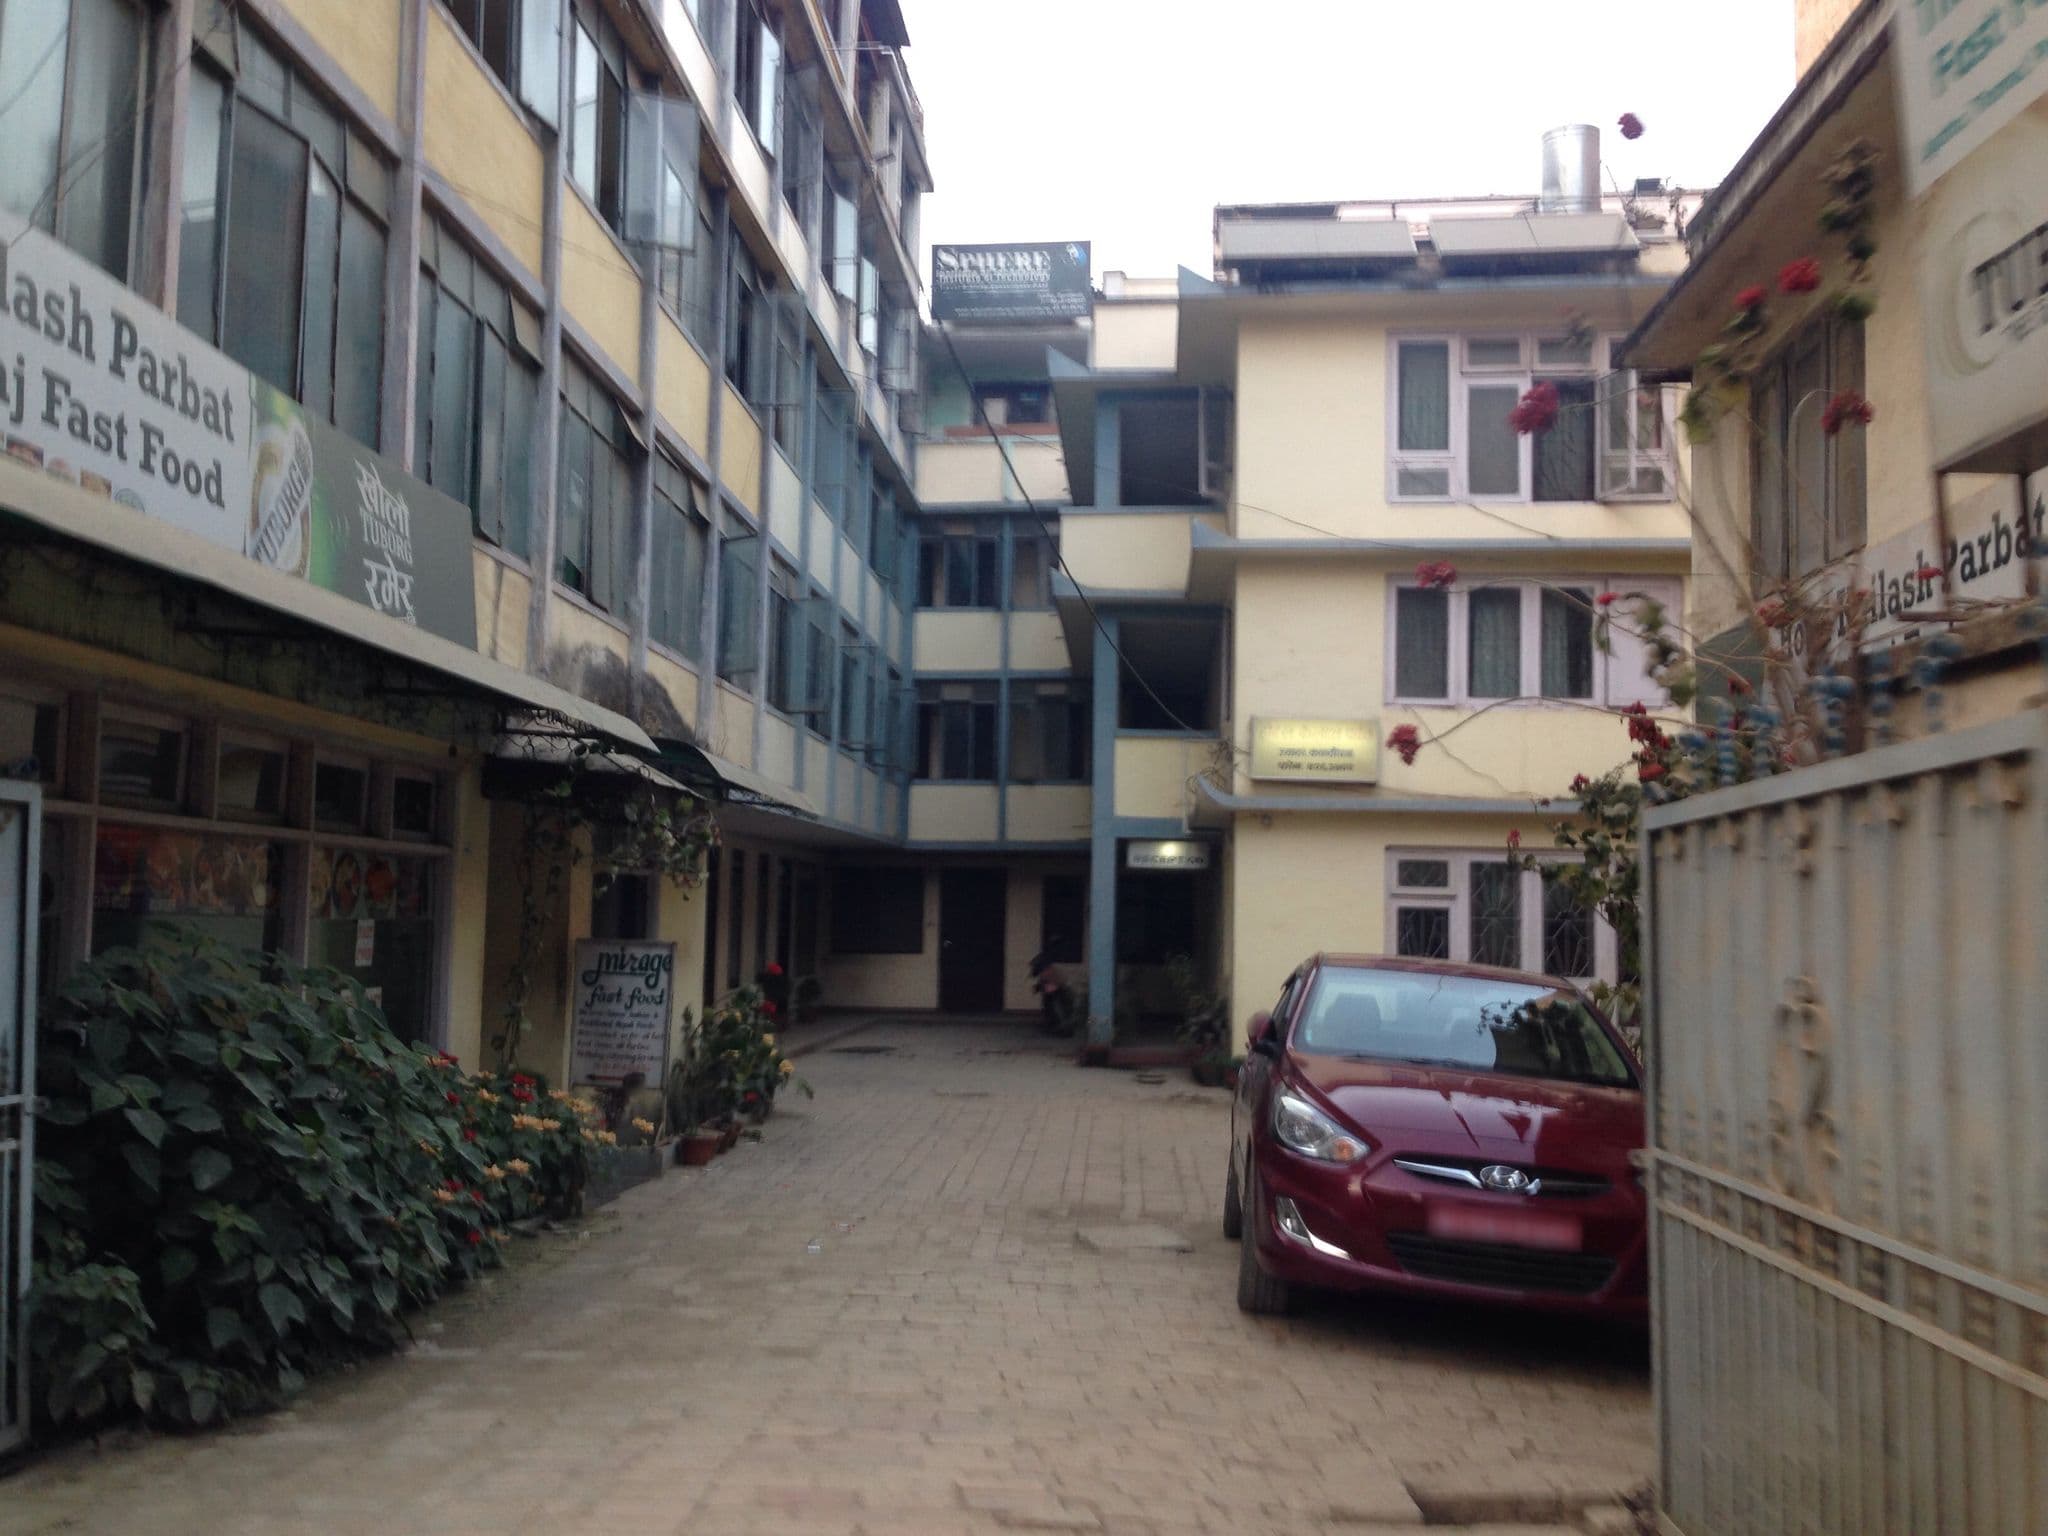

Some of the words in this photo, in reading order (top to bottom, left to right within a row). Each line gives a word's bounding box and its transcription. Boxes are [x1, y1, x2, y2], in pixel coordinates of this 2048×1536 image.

[109, 310, 235, 444] Parbat
[41, 367, 129, 461] Fast
[138, 419, 226, 510] Food
[253, 458, 306, 563] TUBORG
[359, 506, 413, 567] TUBORG
[583, 947, 672, 989] mirage
[586, 983, 623, 1008] fast
[624, 986, 665, 1010] food
